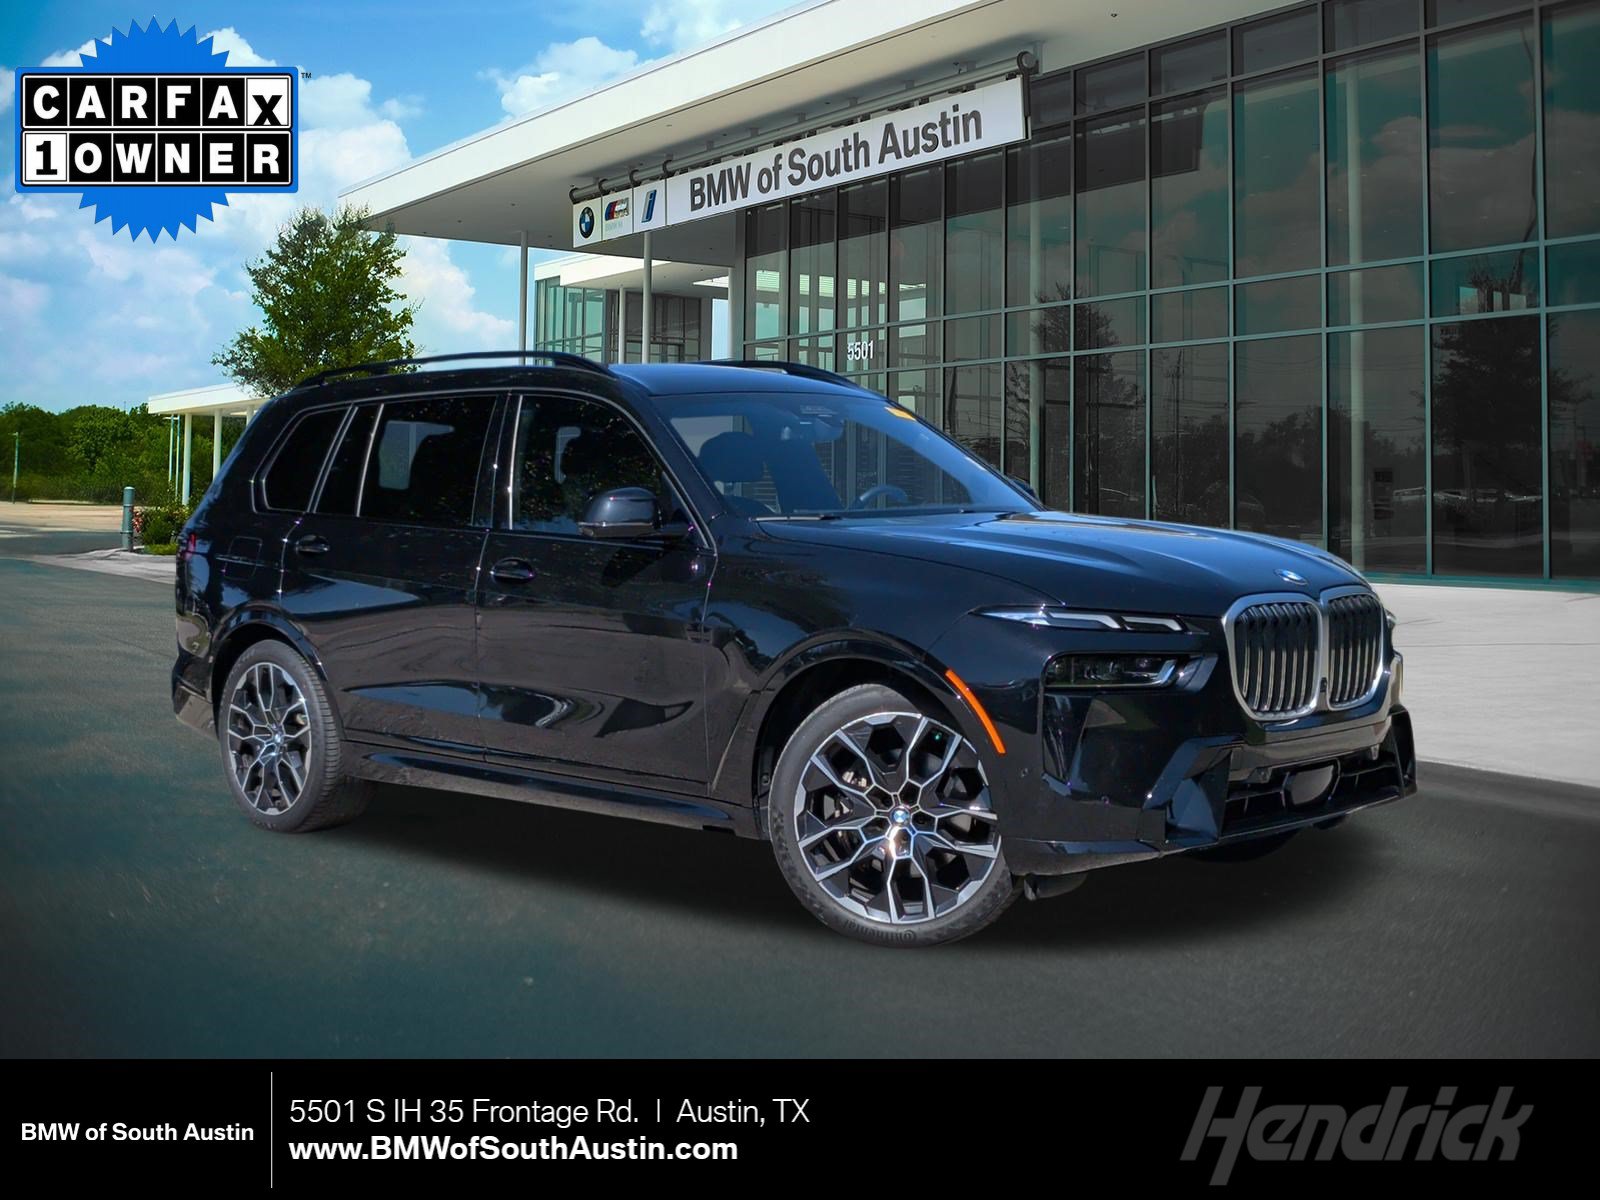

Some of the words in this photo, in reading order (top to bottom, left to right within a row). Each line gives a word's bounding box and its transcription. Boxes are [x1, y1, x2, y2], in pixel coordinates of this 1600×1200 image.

[690, 162, 752, 211] BMW
[757, 153, 783, 194] of
[787, 132, 870, 186] South
[878, 103, 982, 164] Austin
[847, 340, 874, 361] 5501
